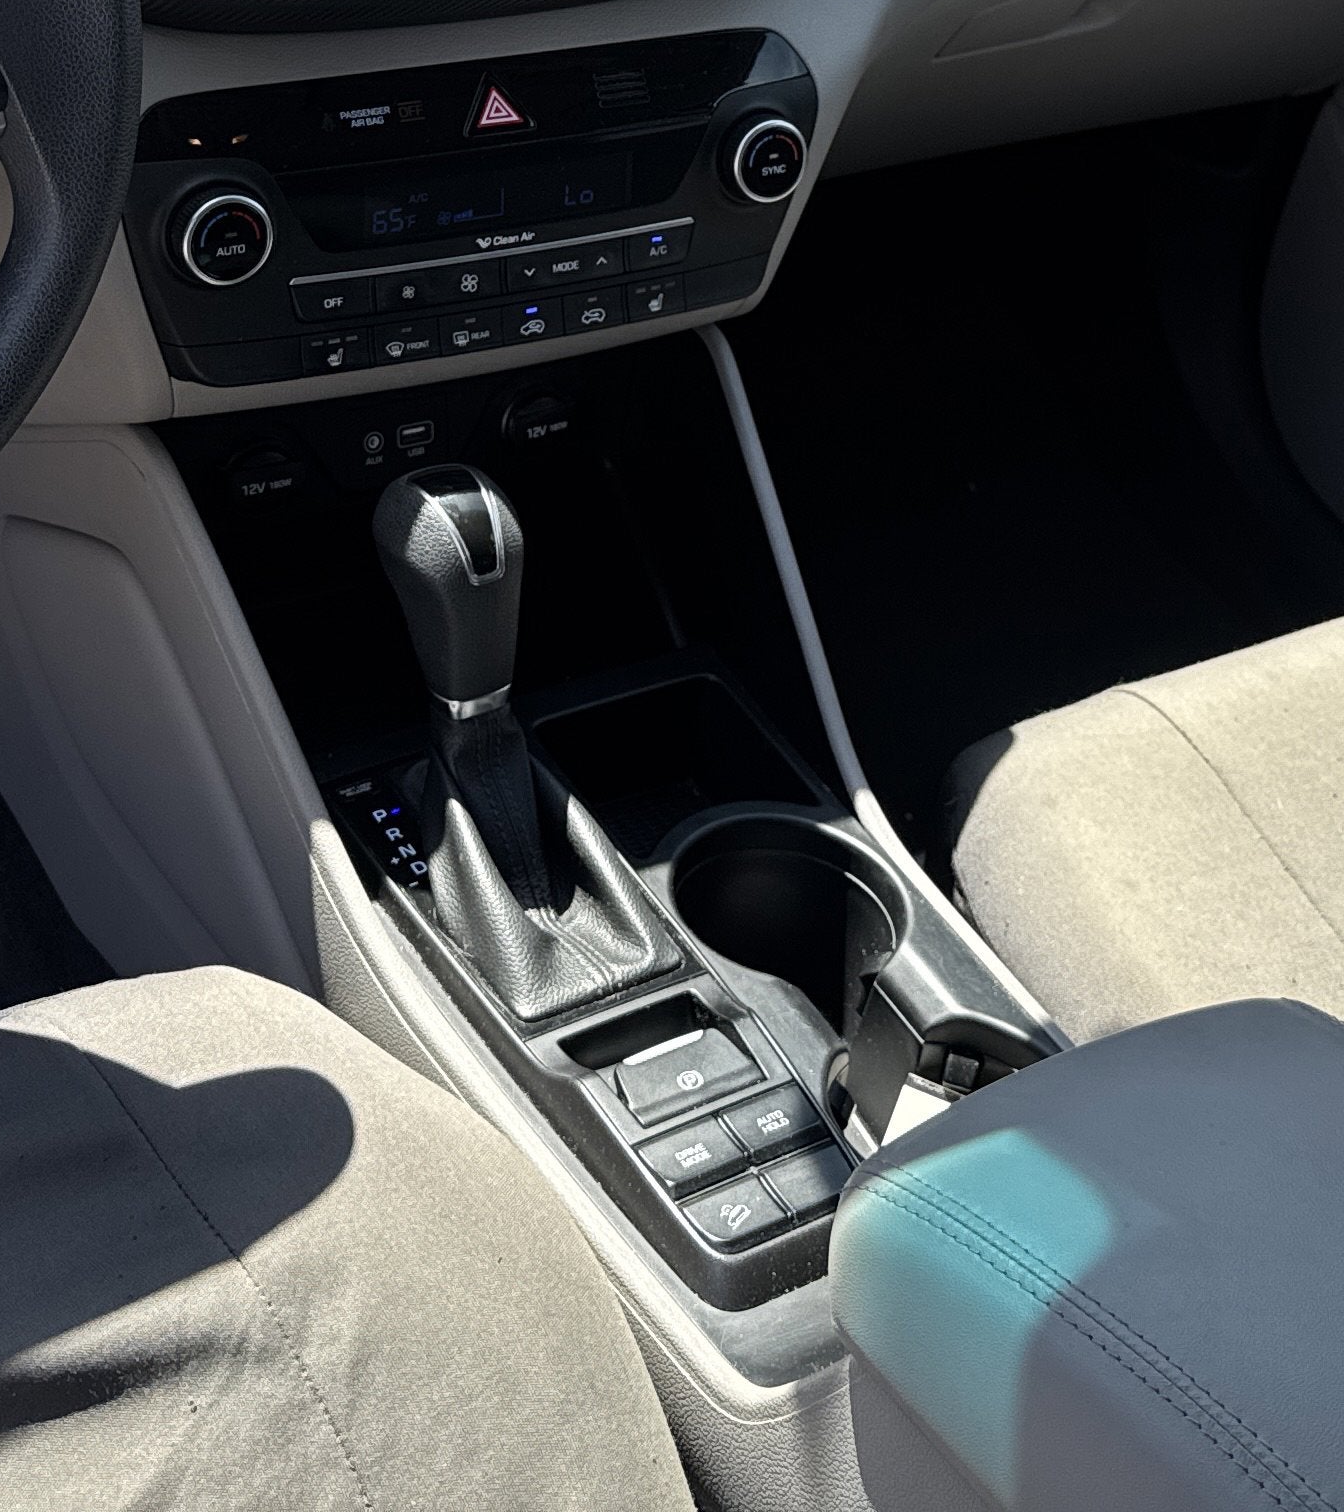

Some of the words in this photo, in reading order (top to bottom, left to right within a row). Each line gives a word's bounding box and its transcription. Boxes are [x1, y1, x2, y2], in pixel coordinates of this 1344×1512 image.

[339, 106, 391, 120] PASSENGER
[398, 103, 424, 119] OFF
[351, 118, 365, 128] AIR
[366, 116, 385, 126] BAG
[761, 164, 787, 177] SYNC
[493, 234, 520, 247] Clean
[521, 231, 535, 243] Air
[216, 244, 246, 257] AUTO
[649, 245, 668, 257] A/C
[552, 260, 580, 275] MODE
[323, 297, 344, 309] OFF
[470, 330, 490, 340] REAR
[406, 340, 430, 350] FRONT
[526, 424, 548, 439] 12V
[407, 447, 425, 458] USB
[365, 456, 383, 467] AUX
[241, 481, 266, 497] 12V
[372, 808, 387, 823] P
[386, 827, 404, 841] R
[398, 843, 416, 859] N
[410, 860, 428, 875] D
[757, 1110, 784, 1126] AUTO
[761, 1117, 789, 1134] HOLD
[680, 1149, 712, 1168] MODE
